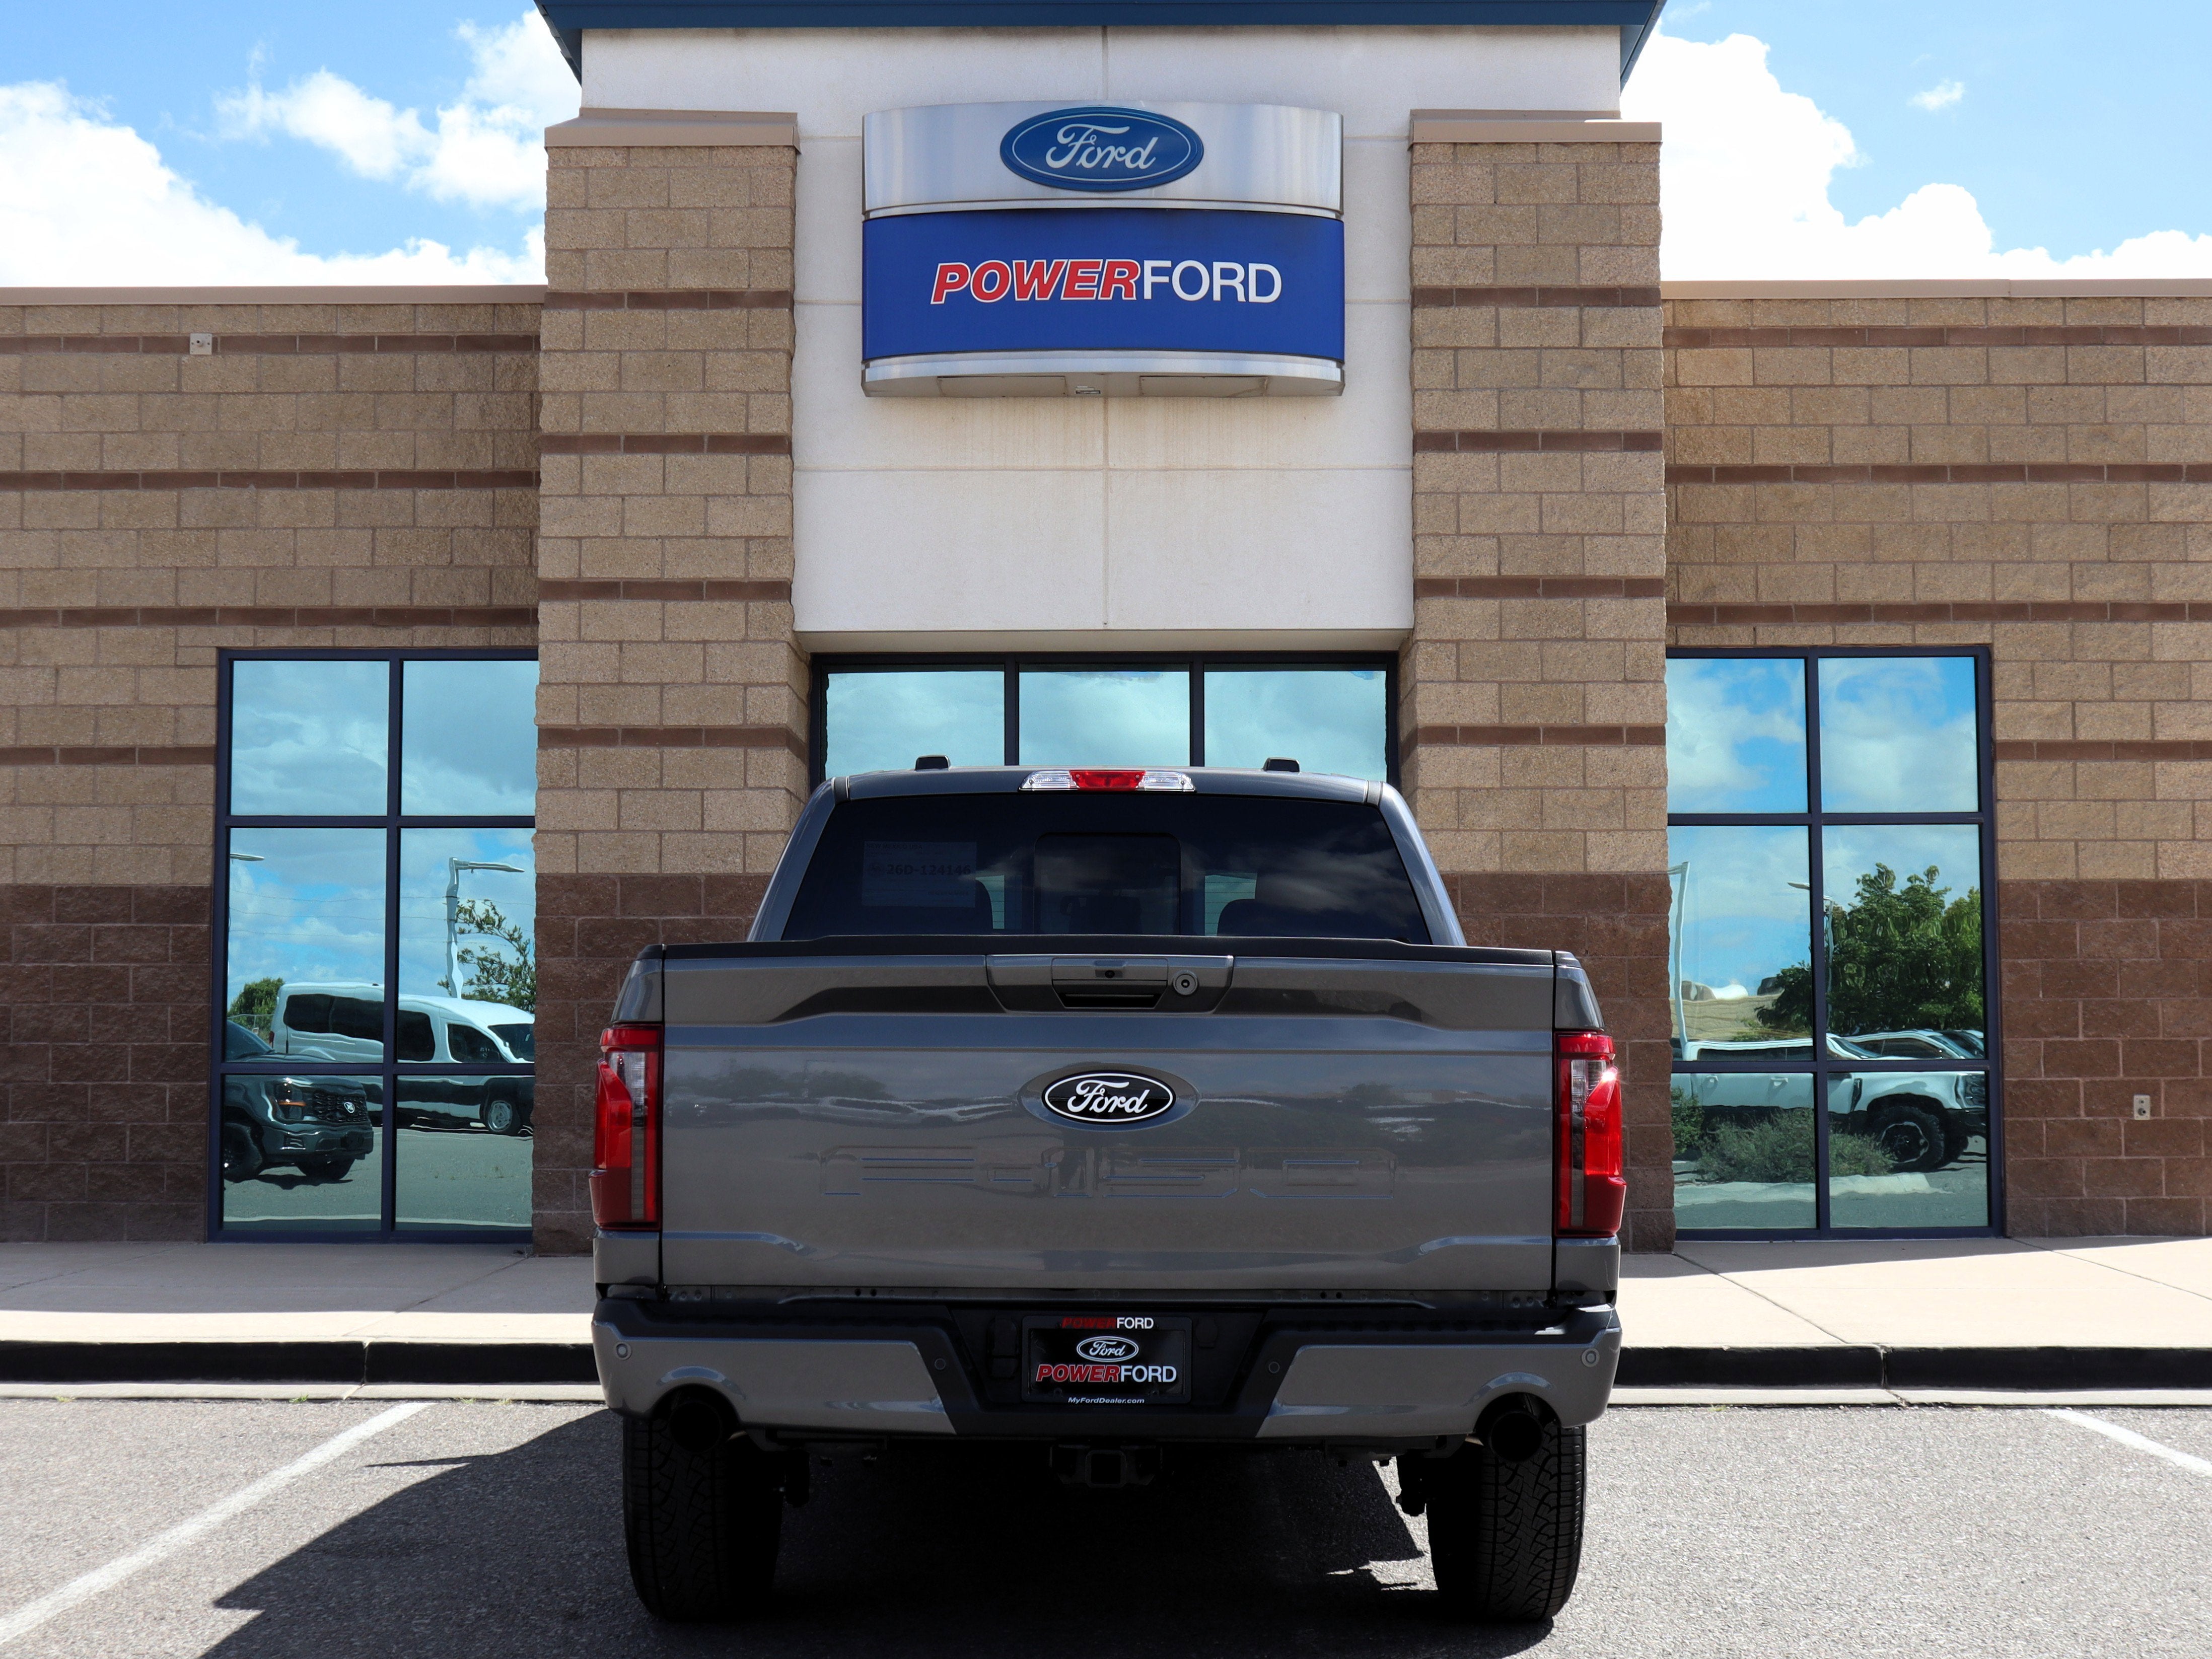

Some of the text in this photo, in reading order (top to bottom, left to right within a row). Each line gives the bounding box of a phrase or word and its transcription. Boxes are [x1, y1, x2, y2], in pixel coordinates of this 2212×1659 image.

[1045, 123, 1159, 170] Ford
[930, 258, 1283, 305] POWERFORD
[1066, 1079, 1151, 1114] Ford
[1061, 1317, 1155, 1330] POWERFORD
[1089, 1340, 1126, 1357] Ford
[1035, 1363, 1177, 1383] POWERFORD
